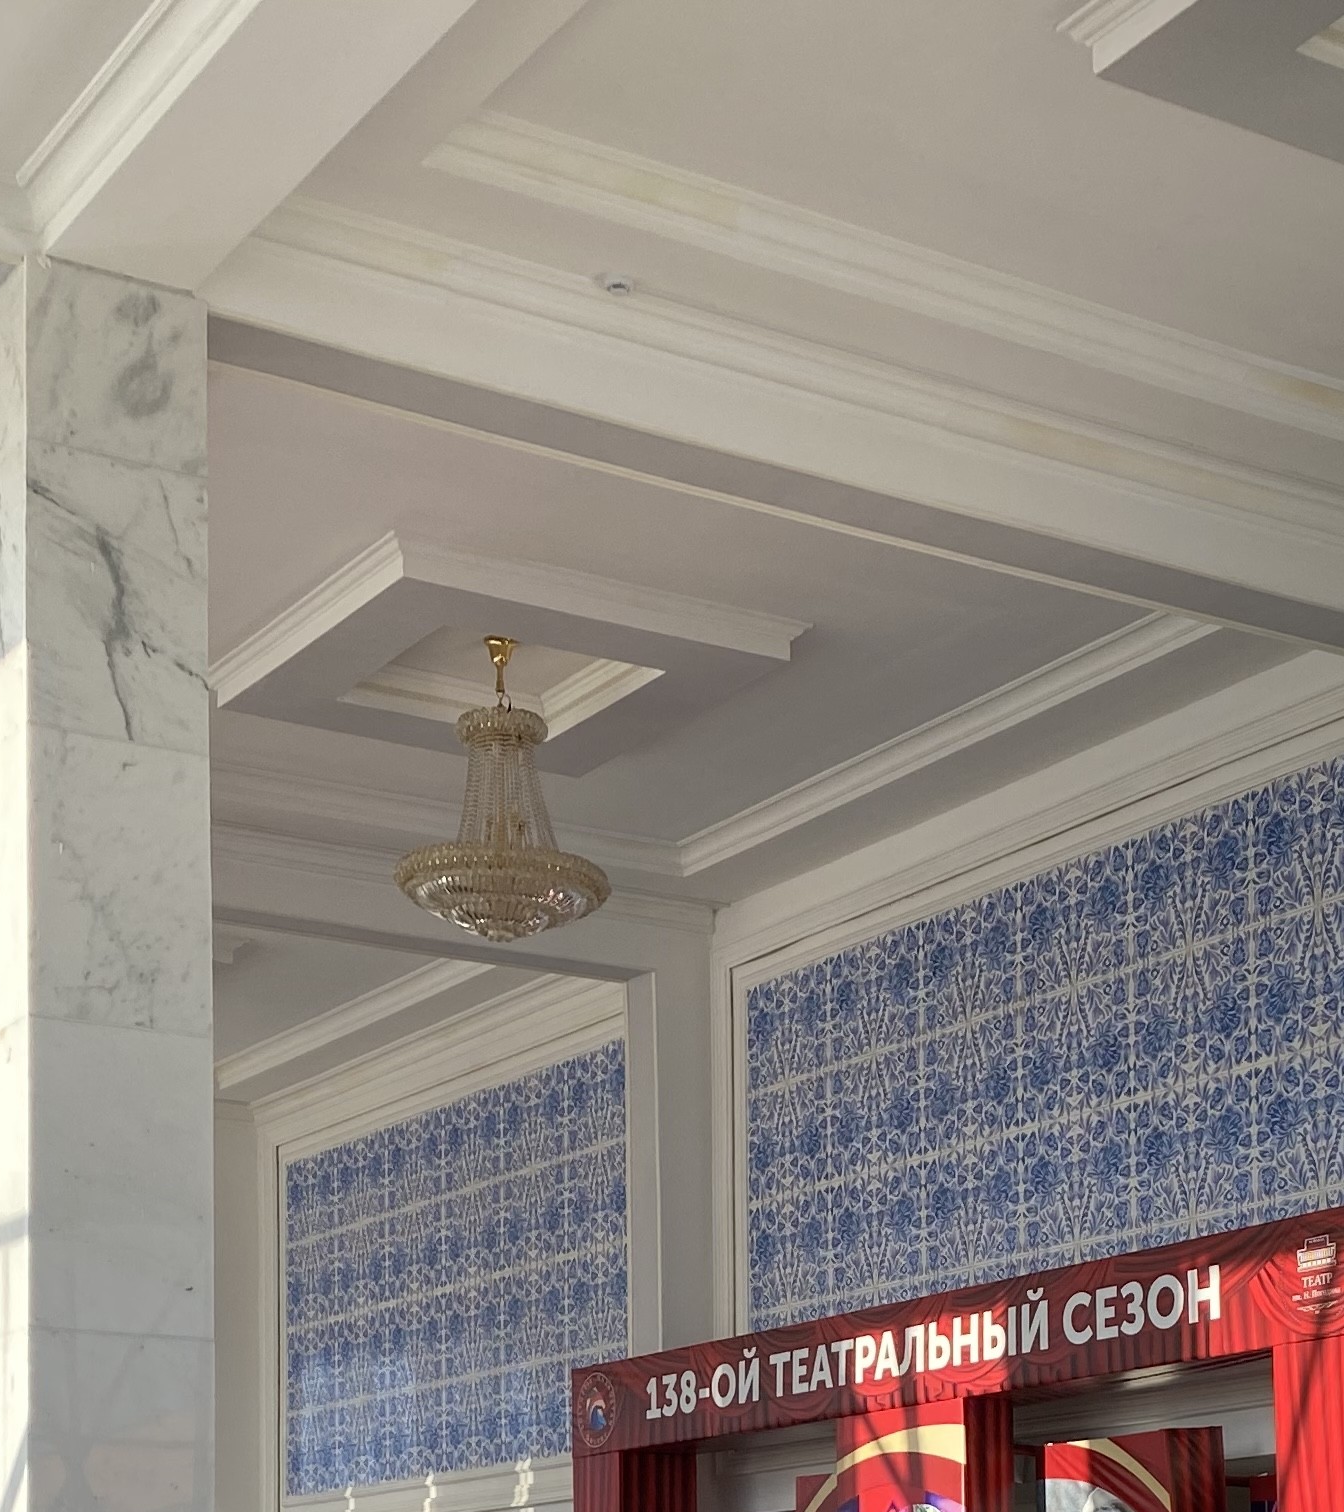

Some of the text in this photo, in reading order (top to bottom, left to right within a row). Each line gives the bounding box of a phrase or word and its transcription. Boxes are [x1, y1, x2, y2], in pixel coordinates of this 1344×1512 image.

[1301, 1272, 1333, 1288] ТЕАТР
[645, 1346, 760, 1420] 138-ОЙ
[769, 1287, 1049, 1398] ТЕАТРАЛЬНЫЙ
[1062, 1264, 1221, 1345] СЕЗОН
